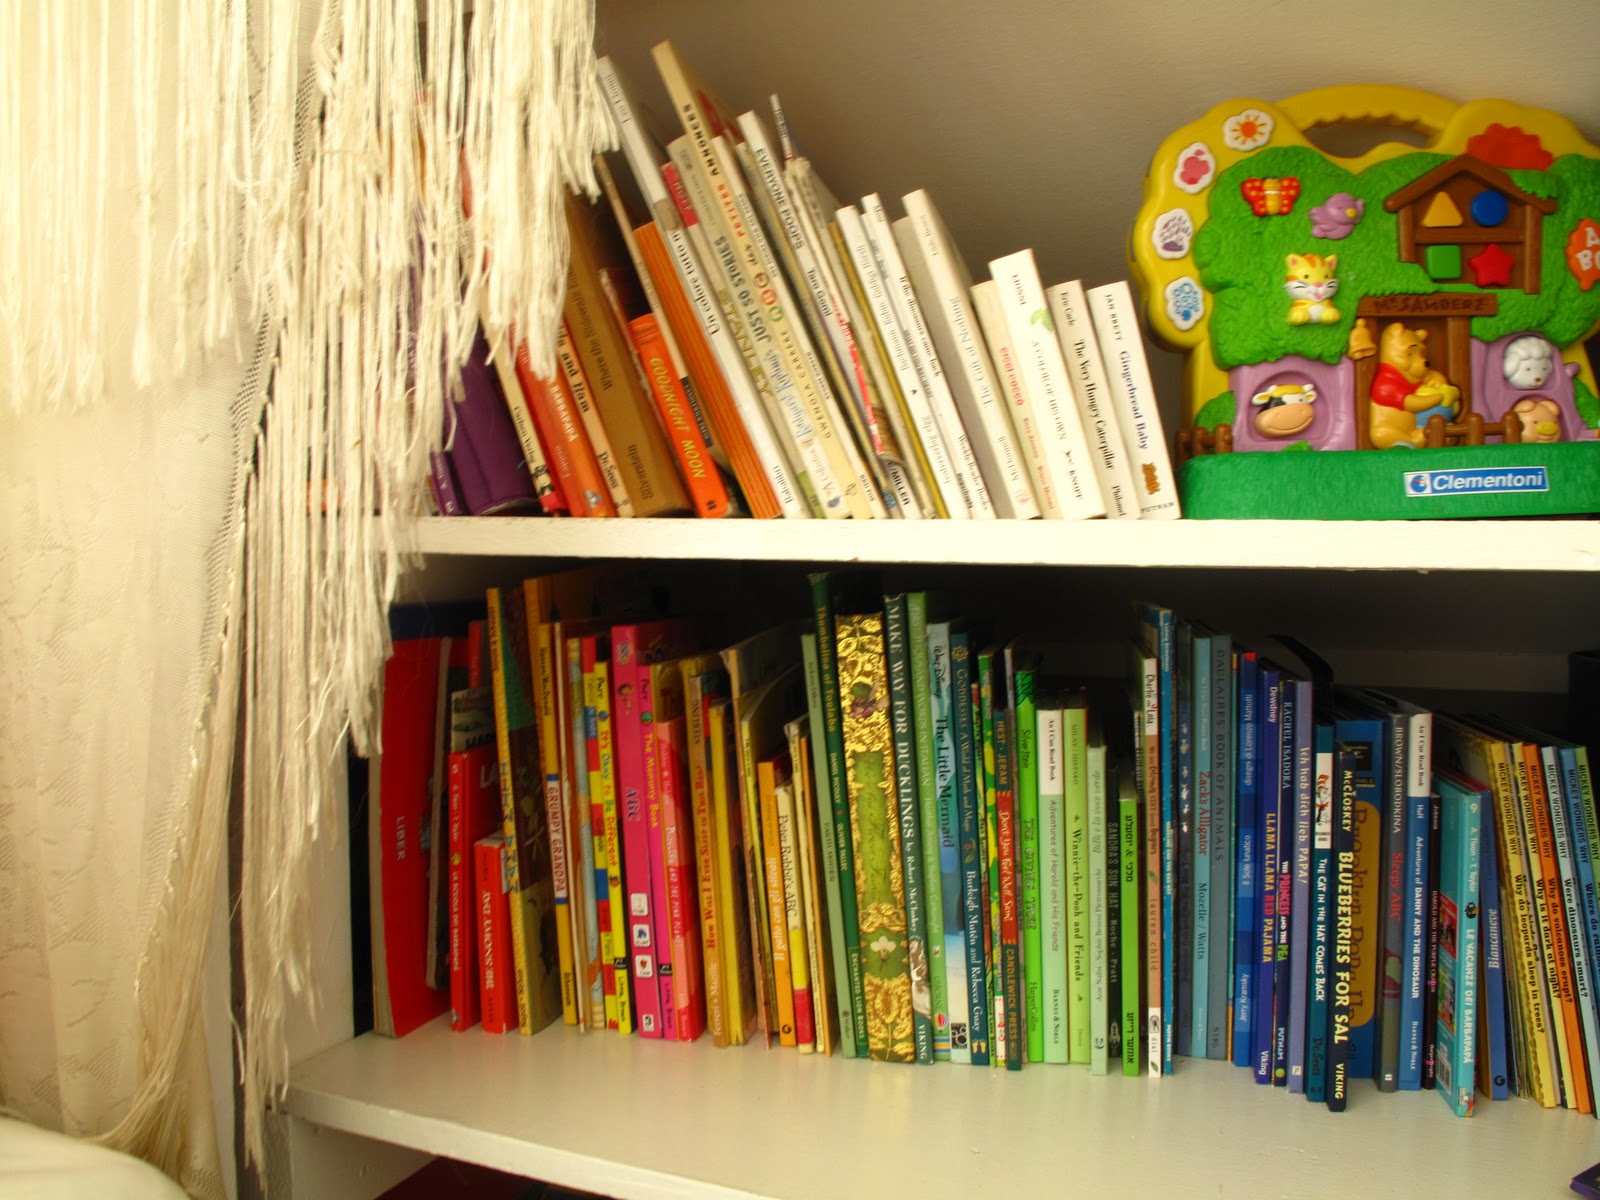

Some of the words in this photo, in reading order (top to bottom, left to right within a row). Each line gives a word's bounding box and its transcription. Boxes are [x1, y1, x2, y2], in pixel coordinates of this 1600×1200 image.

[680, 102, 721, 177] ANNONCES
[715, 182, 747, 238] PETITES
[752, 148, 788, 209] EVERYONE
[779, 208, 805, 249] POOPS
[674, 246, 695, 276] tutto
[713, 235, 746, 287] STORIES
[687, 276, 712, 314] colore
[737, 287, 755, 308] SO
[805, 267, 822, 289] Taro
[814, 289, 834, 316] Gomi
[1104, 293, 1115, 310] JAN
[570, 290, 596, 338] Sidewalk
[703, 313, 721, 335] Un
[746, 307, 772, 344] JUST
[900, 282, 912, 297] the
[919, 336, 934, 357] came
[927, 357, 942, 377] back
[945, 296, 973, 343] Nothing
[1063, 307, 1076, 327] Carle
[1109, 312, 1123, 341] BRETT
[587, 338, 603, 356] the
[716, 286, 774, 399] STANLEY
[963, 343, 978, 358] of
[1072, 339, 1088, 359] The
[560, 350, 578, 377] and
[572, 381, 592, 412] Ham
[593, 355, 615, 390] Where
[1076, 359, 1093, 382] Very
[1114, 349, 1146, 419] Gingerbread
[977, 383, 995, 406] The
[1042, 383, 1053, 397] OF
[1081, 382, 1103, 419] Hungry
[647, 355, 691, 435] GOODNIGHT
[679, 436, 709, 481] MOON
[1052, 416, 1066, 440] OWN
[1090, 419, 1117, 471] Caterpillar
[1132, 421, 1151, 450] Baby
[625, 443, 653, 500] Silverstein
[1433, 472, 1543, 491] Clementoni
[1110, 484, 1127, 517] Philomel
[815, 606, 832, 671] Thumbelina
[886, 605, 902, 653] MAKE
[821, 674, 833, 686] of
[890, 659, 905, 693] WAY
[823, 687, 838, 732] Toulaba
[893, 699, 908, 734] FOR
[1267, 686, 1277, 722] Dewdney
[935, 715, 949, 743] The
[1282, 701, 1291, 742] RACHEL
[937, 746, 951, 781] Little
[1215, 734, 1225, 769] BOOK
[1281, 745, 1290, 789] ISADORA
[644, 755, 657, 798] Mommy
[896, 740, 916, 838] DUCKLINGS
[1197, 771, 1210, 804] Zack's
[1215, 774, 1224, 791] OF
[1298, 768, 1310, 788] hab
[1392, 726, 1403, 833] BROWN/SLOBODKINA
[1497, 762, 1508, 791] MICKEY
[547, 786, 561, 833] GRUMPY
[648, 801, 660, 829] Book
[939, 785, 954, 848] Mermaid
[1298, 793, 1309, 816] dich
[1502, 796, 1514, 834] WONDERS
[605, 815, 617, 867] Different
[775, 814, 789, 843] Peter
[1197, 807, 1209, 854] Alligator
[1214, 797, 1224, 861] ANIMALS
[1266, 813, 1275, 850] LLAMA
[1241, 835, 1251, 861] lunatico
[1508, 837, 1517, 855] WHY
[551, 836, 566, 892] GRANDPA
[778, 845, 794, 889] Rabbit's
[1071, 828, 1083, 916] Winnie-the-Pooh
[1108, 868, 1118, 886] SUN
[1241, 863, 1250, 878] Sole
[1265, 854, 1274, 890] LLAMA
[1297, 847, 1308, 883] PAPA!
[1390, 852, 1402, 891] Sleepy
[963, 870, 977, 910] Burleigh
[1050, 889, 1058, 903] and
[1108, 892, 1119, 907] HAT
[1317, 876, 1327, 891] CAT
[1513, 874, 1523, 895] Why
[1534, 878, 1545, 899] Why
[1545, 877, 1556, 899] Why
[1563, 878, 1574, 903] Were
[783, 891, 797, 917] ABC
[1050, 906, 1058, 919] His
[1196, 882, 1207, 921] Mozelle
[1264, 894, 1273, 914] RED
[1335, 851, 1354, 962] BLUEBERRIES
[1391, 893, 1401, 921] ABC
[1413, 887, 1421, 915] DANNY
[1516, 898, 1526, 911] do
[1537, 903, 1546, 911] is
[1549, 902, 1559, 914] do
[1073, 921, 1083, 939] and
[1108, 920, 1119, 946] Roche
[1149, 899, 1157, 937] lauren
[1316, 924, 1326, 942] HAT
[1466, 929, 1475, 939] LE
[1567, 906, 1582, 957] dinosaurs
[1050, 921, 1059, 951] Friends
[1196, 931, 1205, 959] Watts
[1263, 918, 1273, 962] PAJAMA
[1412, 938, 1420, 953] THE
[1486, 908, 1499, 968] Biancaneve
[1519, 913, 1533, 958] leopards
[1540, 925, 1552, 950] dark
[1551, 916, 1567, 969] volcanoes
[968, 946, 979, 963] and
[1073, 944, 1084, 981] Friends
[1149, 942, 1157, 971] child
[1277, 945, 1288, 961] PEA
[1315, 945, 1325, 974] COMES
[1464, 942, 1475, 986] VACANZE
[1544, 953, 1554, 964] at
[969, 966, 981, 1001] Rebecca
[1005, 949, 1016, 1007] CANDLEWICK
[1109, 958, 1119, 982] Pratt
[1411, 955, 1419, 998] DINOSAUR
[1525, 960, 1537, 987] sleep
[1546, 966, 1559, 999] night?
[1558, 970, 1572, 1003] erupt?
[1575, 960, 1588, 997] smart?
[1239, 973, 1249, 1002] Kramsky
[1314, 977, 1324, 1001] BACK
[1333, 971, 1350, 1006] FOR
[1463, 990, 1473, 1006] DEI
[1529, 989, 1539, 1000] in
[1028, 982, 1038, 1031] HarperCollins
[1239, 1004, 1248, 1021] Jerry
[1531, 1002, 1544, 1033] trees?
[1007, 1009, 1017, 1039] PRESS
[1333, 1014, 1348, 1044] SAL
[917, 1024, 928, 1059] VIKING
[1276, 1027, 1284, 1060] PUTNAM
[1258, 1050, 1268, 1074] Viking
[1334, 1063, 1344, 1098] VIKING
